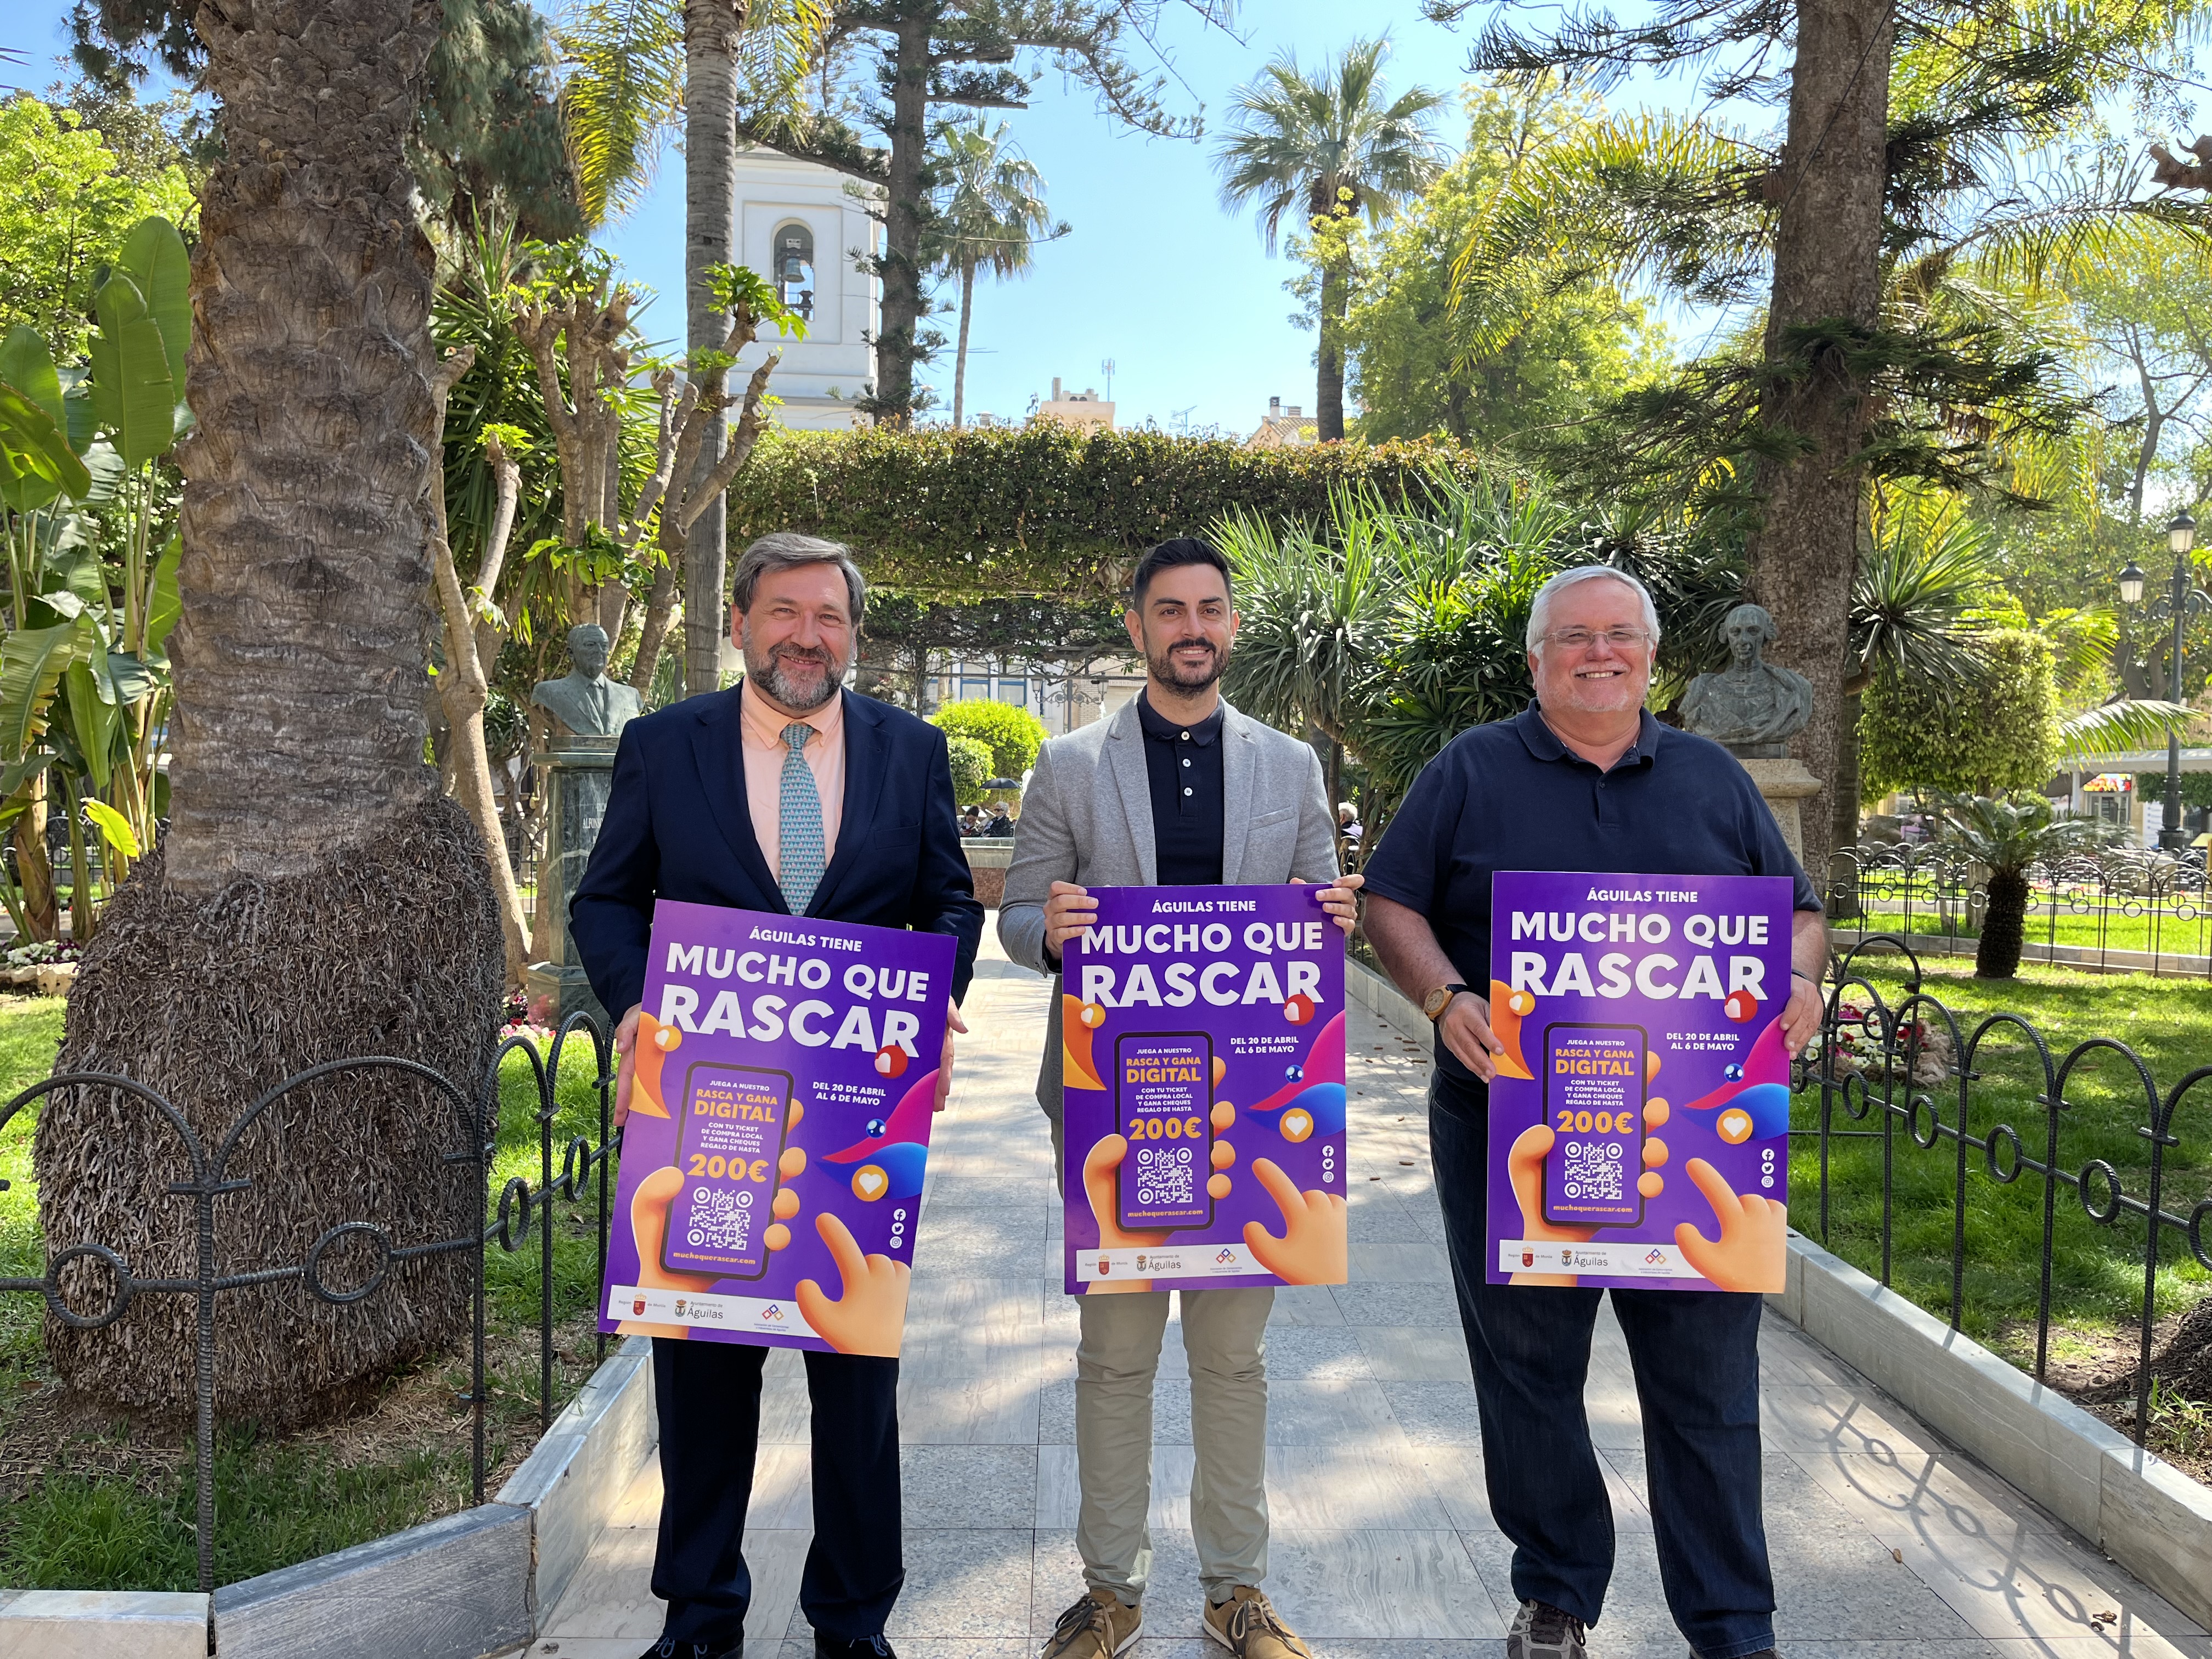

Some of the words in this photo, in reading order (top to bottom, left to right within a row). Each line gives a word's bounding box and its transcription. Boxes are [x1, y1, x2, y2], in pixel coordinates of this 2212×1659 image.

[1587, 887, 1652, 902] ÁGUILAS
[1656, 891, 1698, 902] TIENE
[1152, 899, 1214, 913] ÁGUILAS
[1216, 900, 1256, 912] TIENE
[1511, 911, 1671, 944] MUCHO
[1683, 914, 1769, 949] QUE
[748, 926, 816, 946] ÁGUILAS
[820, 936, 862, 952] TIENE
[1081, 923, 1232, 954] MUCHO
[1243, 922, 1323, 955] QUE
[666, 942, 831, 990] MUCHO
[843, 964, 929, 1002] QUE
[1511, 951, 1768, 1001] RASCAR
[1081, 961, 1324, 1008] RASCAR
[658, 984, 919, 1058] RASCAR
[1555, 1048, 1591, 1057] RASCA
[1603, 1049, 1634, 1058] GANA
[1126, 1058, 1160, 1066] RASCA
[1171, 1057, 1201, 1065] GANA
[1555, 1059, 1634, 1075] DIGITAL
[1126, 1067, 1201, 1082] DIGITAL
[739, 1083, 769, 1091] NUESTRO
[812, 1081, 830, 1090] DEL
[859, 1087, 886, 1096] ABRIL
[696, 1088, 732, 1100] RASCA
[736, 1092, 743, 1101] Y
[746, 1094, 777, 1104] GANA
[838, 1094, 850, 1102] DE
[852, 1096, 879, 1105] MAYO
[694, 1100, 775, 1122] DIGITAL
[1128, 1116, 1201, 1139] 200€
[1556, 1110, 1633, 1133] 200€
[729, 1138, 760, 1146] CHEQUES
[687, 1153, 769, 1182] 200€
[1553, 1204, 1632, 1212] muchoquerascar.com
[673, 1252, 755, 1264] muchoquerascar.com
[1148, 1259, 1181, 1272] Águilas
[1573, 1254, 1608, 1267] Águilas
[687, 1305, 723, 1319] Águilas
